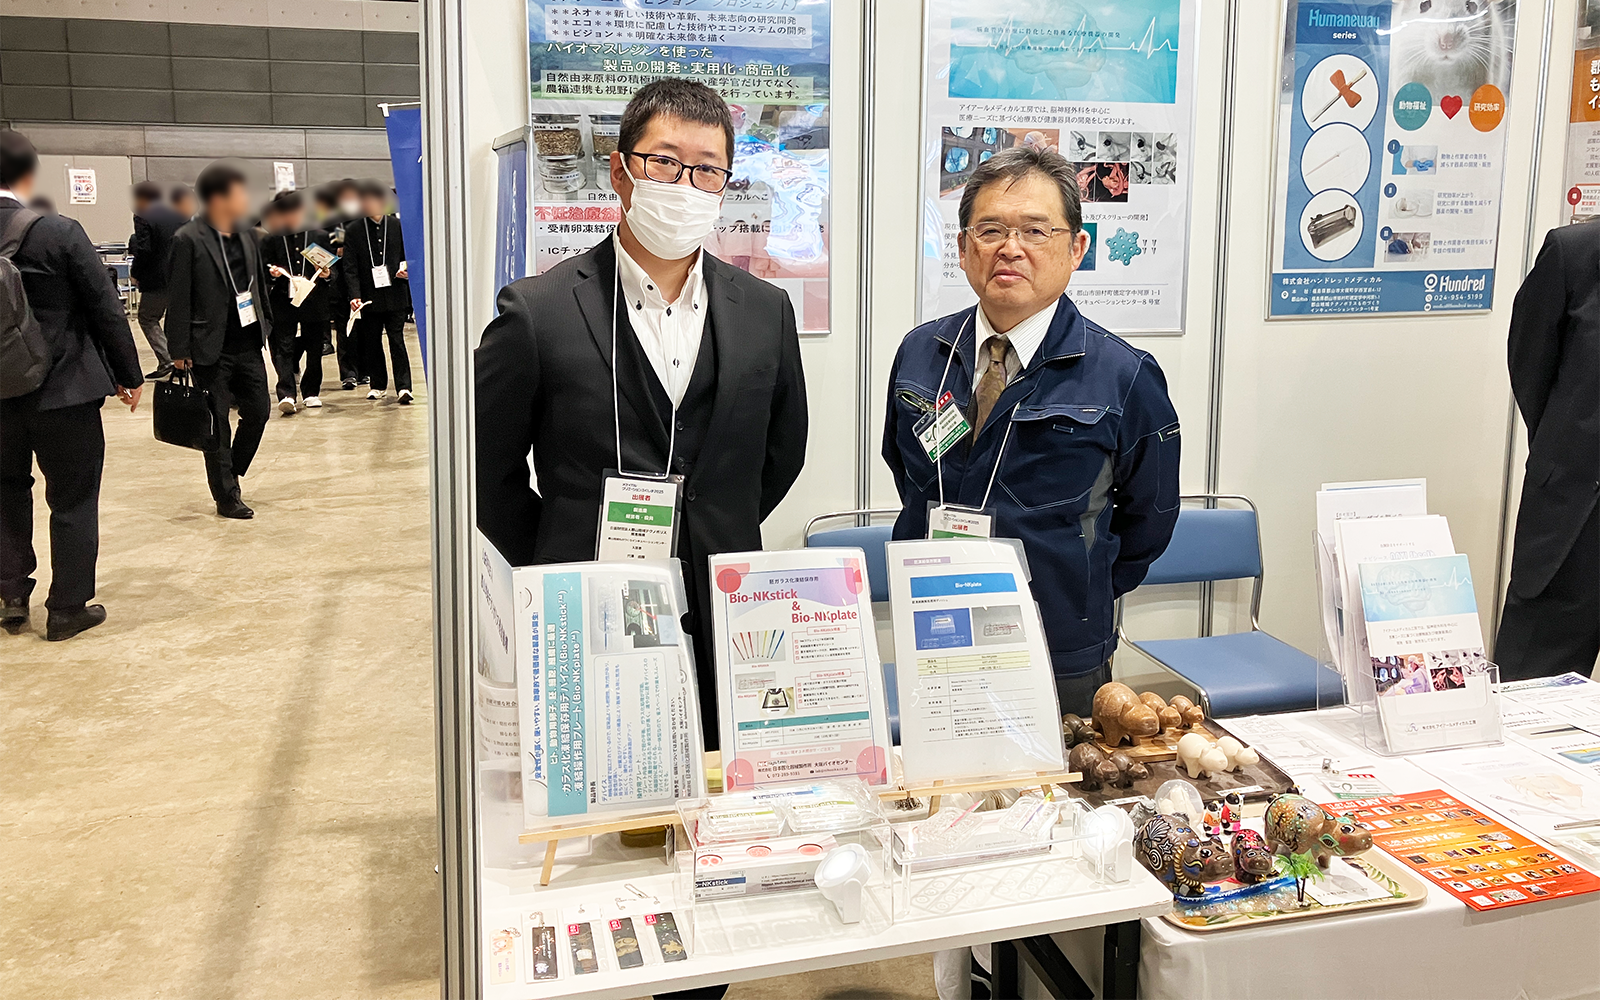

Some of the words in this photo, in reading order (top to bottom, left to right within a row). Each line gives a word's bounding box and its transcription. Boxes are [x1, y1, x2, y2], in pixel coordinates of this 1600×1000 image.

[1308, 8, 1381, 30] Humaneway
[1332, 31, 1357, 40] series
[534, 206, 622, 221] 不妊治療分
[1439, 274, 1486, 293] Hundred
[729, 588, 798, 604] Bio-NKstick
[791, 601, 801, 611] &
[791, 610, 858, 623] Bio-NKplate
